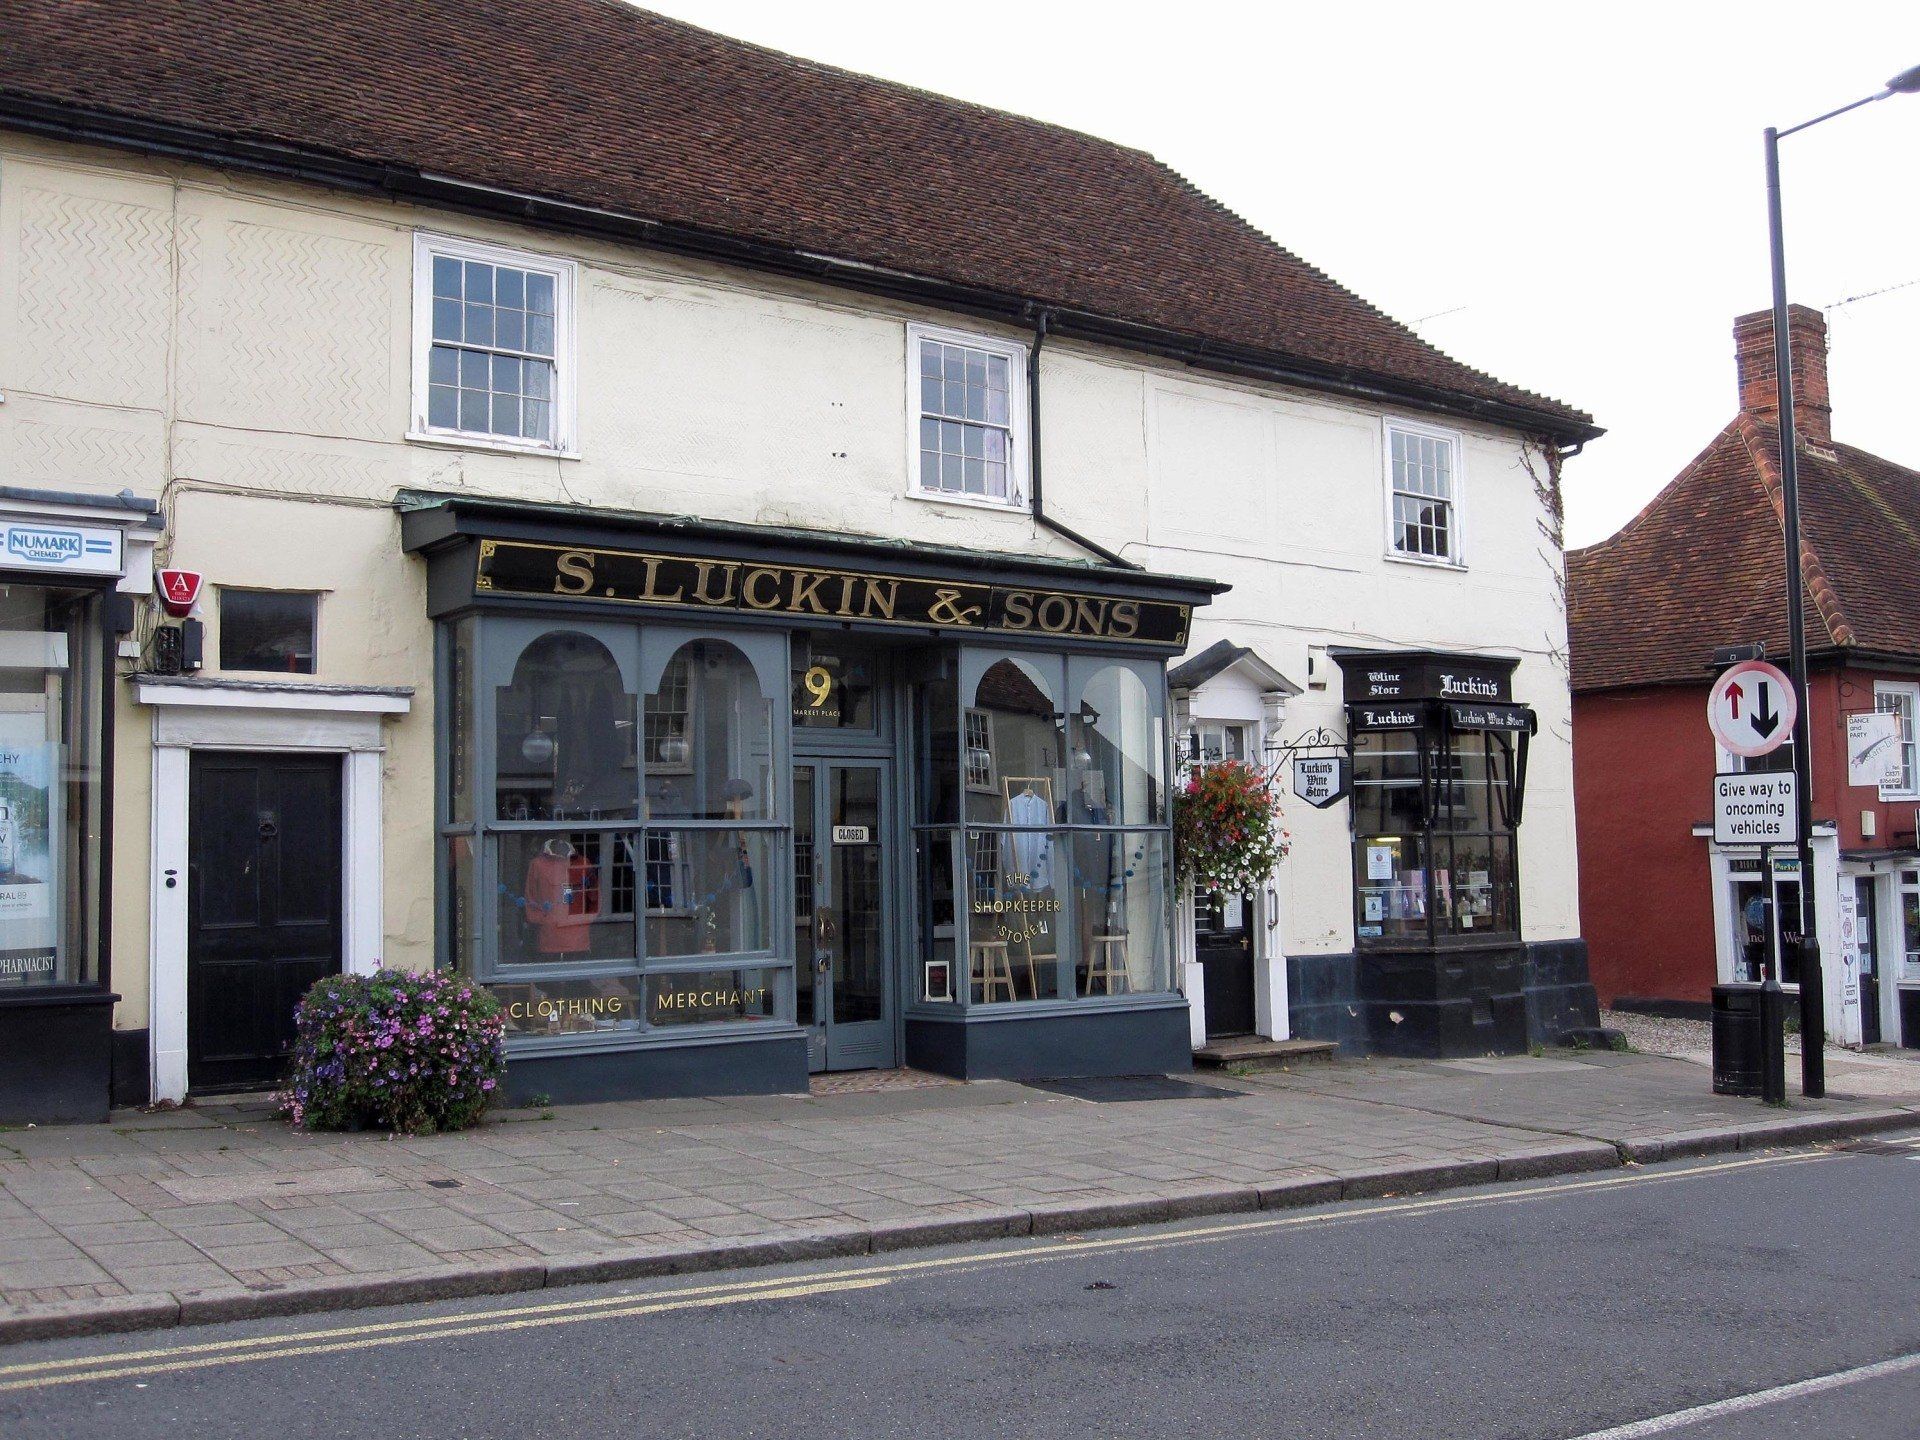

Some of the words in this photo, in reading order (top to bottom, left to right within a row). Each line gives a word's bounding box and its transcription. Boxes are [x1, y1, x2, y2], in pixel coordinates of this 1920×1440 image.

[12, 535, 79, 552] NUMARK
[28, 550, 63, 558] CHEMIST
[171, 573, 189, 591] A
[553, 551, 615, 597] S.
[639, 558, 900, 619] LUCKIN
[927, 588, 982, 625] &
[1003, 592, 1140, 638] SONS
[1367, 672, 1400, 682] Wine
[805, 666, 831, 707] 9
[1368, 685, 1400, 696] Store
[1440, 674, 1498, 698] Luckin's
[1364, 711, 1415, 726] Luckin's
[0, 754, 20, 763] HY
[1301, 763, 1333, 774] Luckin's
[1306, 775, 1328, 786] Wine
[1306, 787, 1329, 797] Store
[1719, 782, 1746, 797] Give
[1749, 783, 1774, 798] way
[1778, 780, 1791, 795] to
[1725, 800, 1785, 817] oncoming
[838, 828, 864, 840] CLOSED
[1730, 819, 1781, 835] vehicles
[1006, 872, 1031, 886] THE
[974, 900, 1061, 913] SHOPKEEPER
[998, 923, 1038, 943] STORE
[510, 997, 622, 1019] CLOTHING
[658, 988, 766, 1010] MERCHANT
